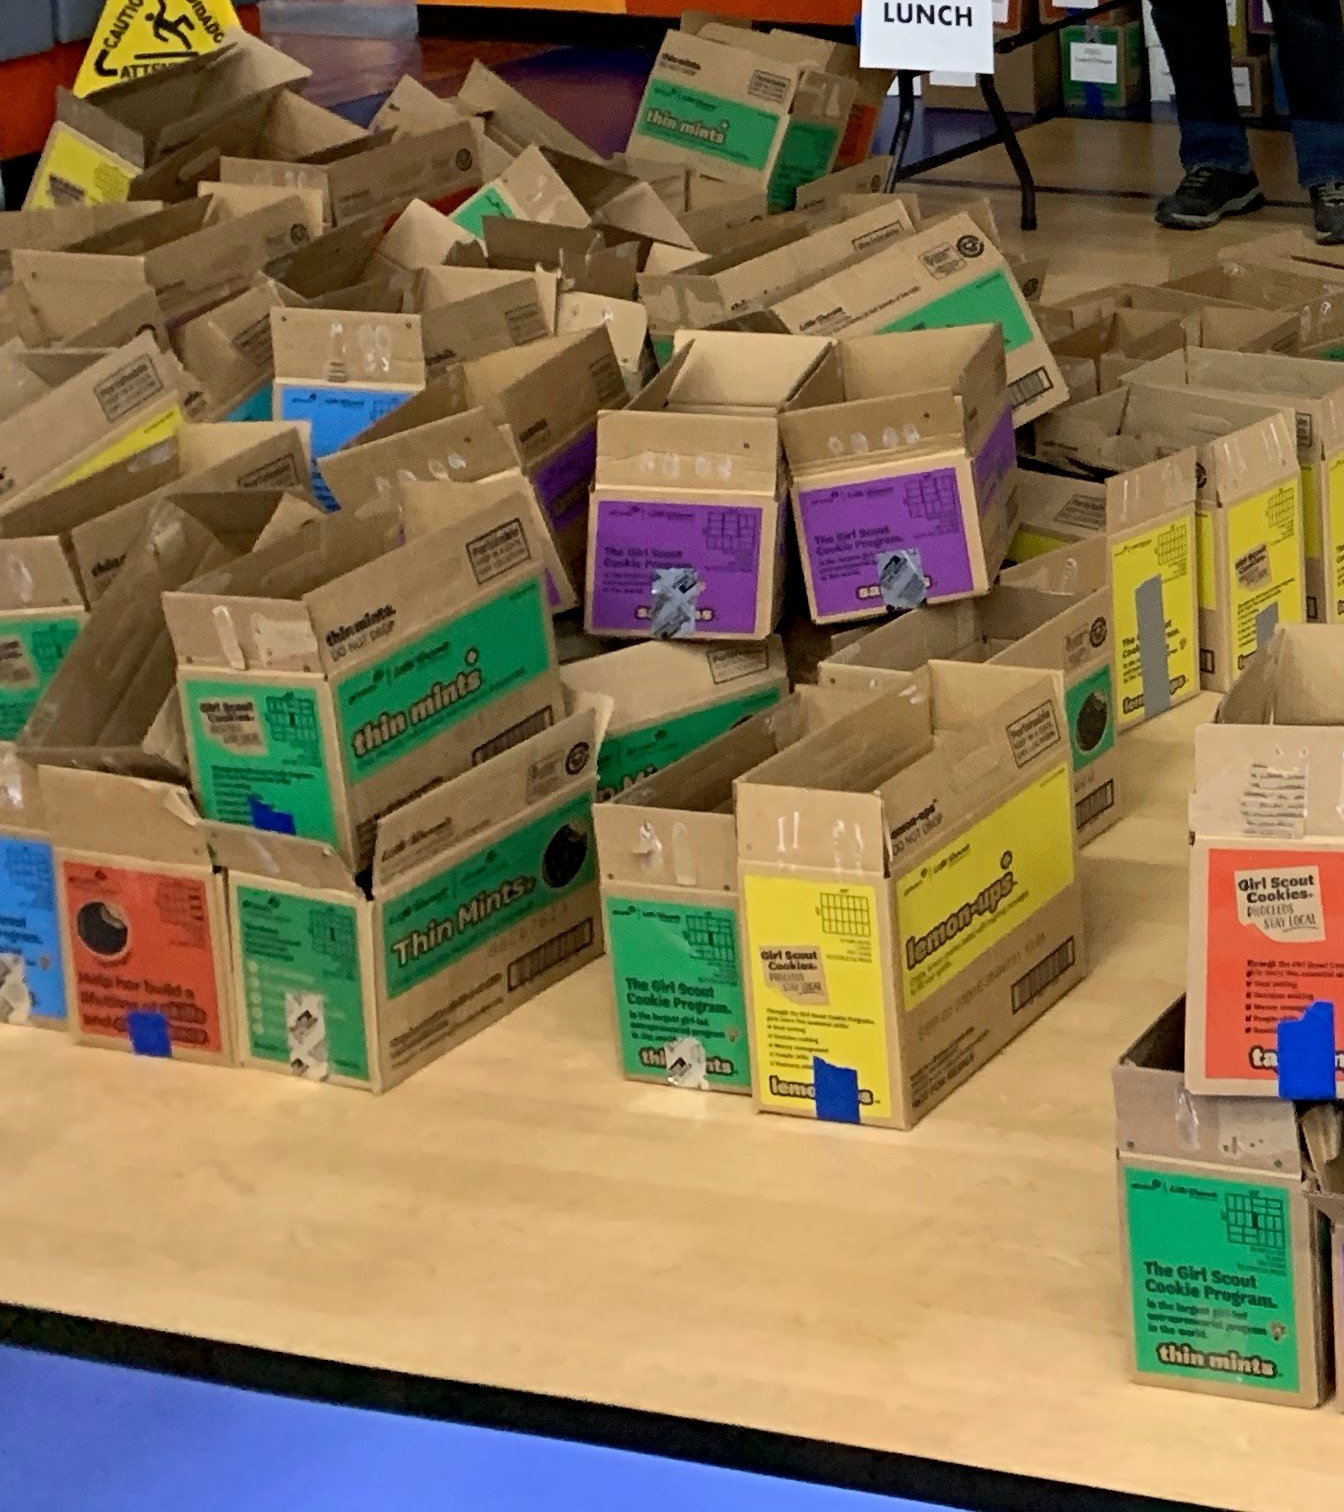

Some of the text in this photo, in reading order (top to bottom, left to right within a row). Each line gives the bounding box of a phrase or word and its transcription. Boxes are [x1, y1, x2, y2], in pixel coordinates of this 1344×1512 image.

[884, 2, 972, 27] LUNCH
[646, 108, 725, 145] thin mints
[353, 668, 482, 758] thin mints
[1238, 875, 1314, 891] Girl Scout
[392, 918, 452, 966] Thin
[626, 977, 648, 992] The
[626, 993, 670, 1007] Cookie
[1144, 1261, 1256, 1288] The Girl Scout
[1146, 1279, 1199, 1298] Cookie
[1156, 1342, 1277, 1378] thin mints
